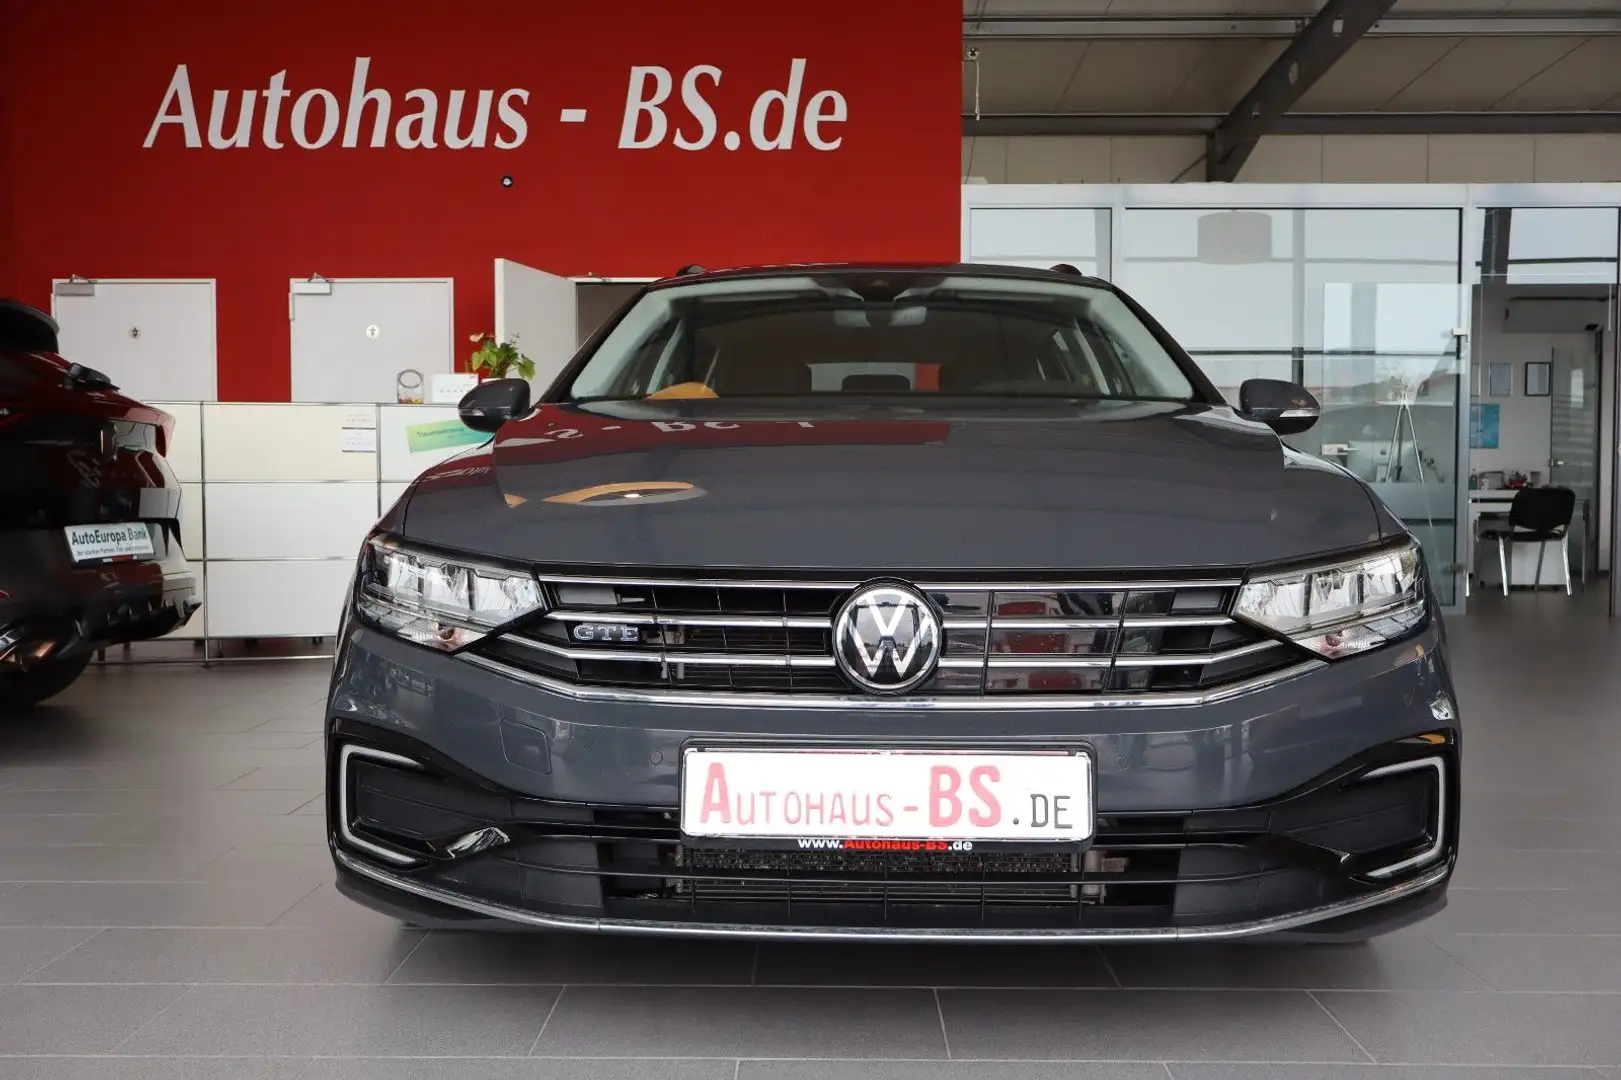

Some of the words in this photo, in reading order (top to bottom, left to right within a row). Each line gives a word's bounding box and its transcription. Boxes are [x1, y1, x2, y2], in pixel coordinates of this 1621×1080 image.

[142, 56, 531, 151] Autohaus
[617, 57, 849, 152] BS.de
[71, 530, 127, 546] AutoEuropa
[127, 526, 148, 541] Bank
[573, 623, 640, 642] GTE
[846, 588, 934, 679] VW
[797, 838, 973, 851] www.Autohaus-BS.de
